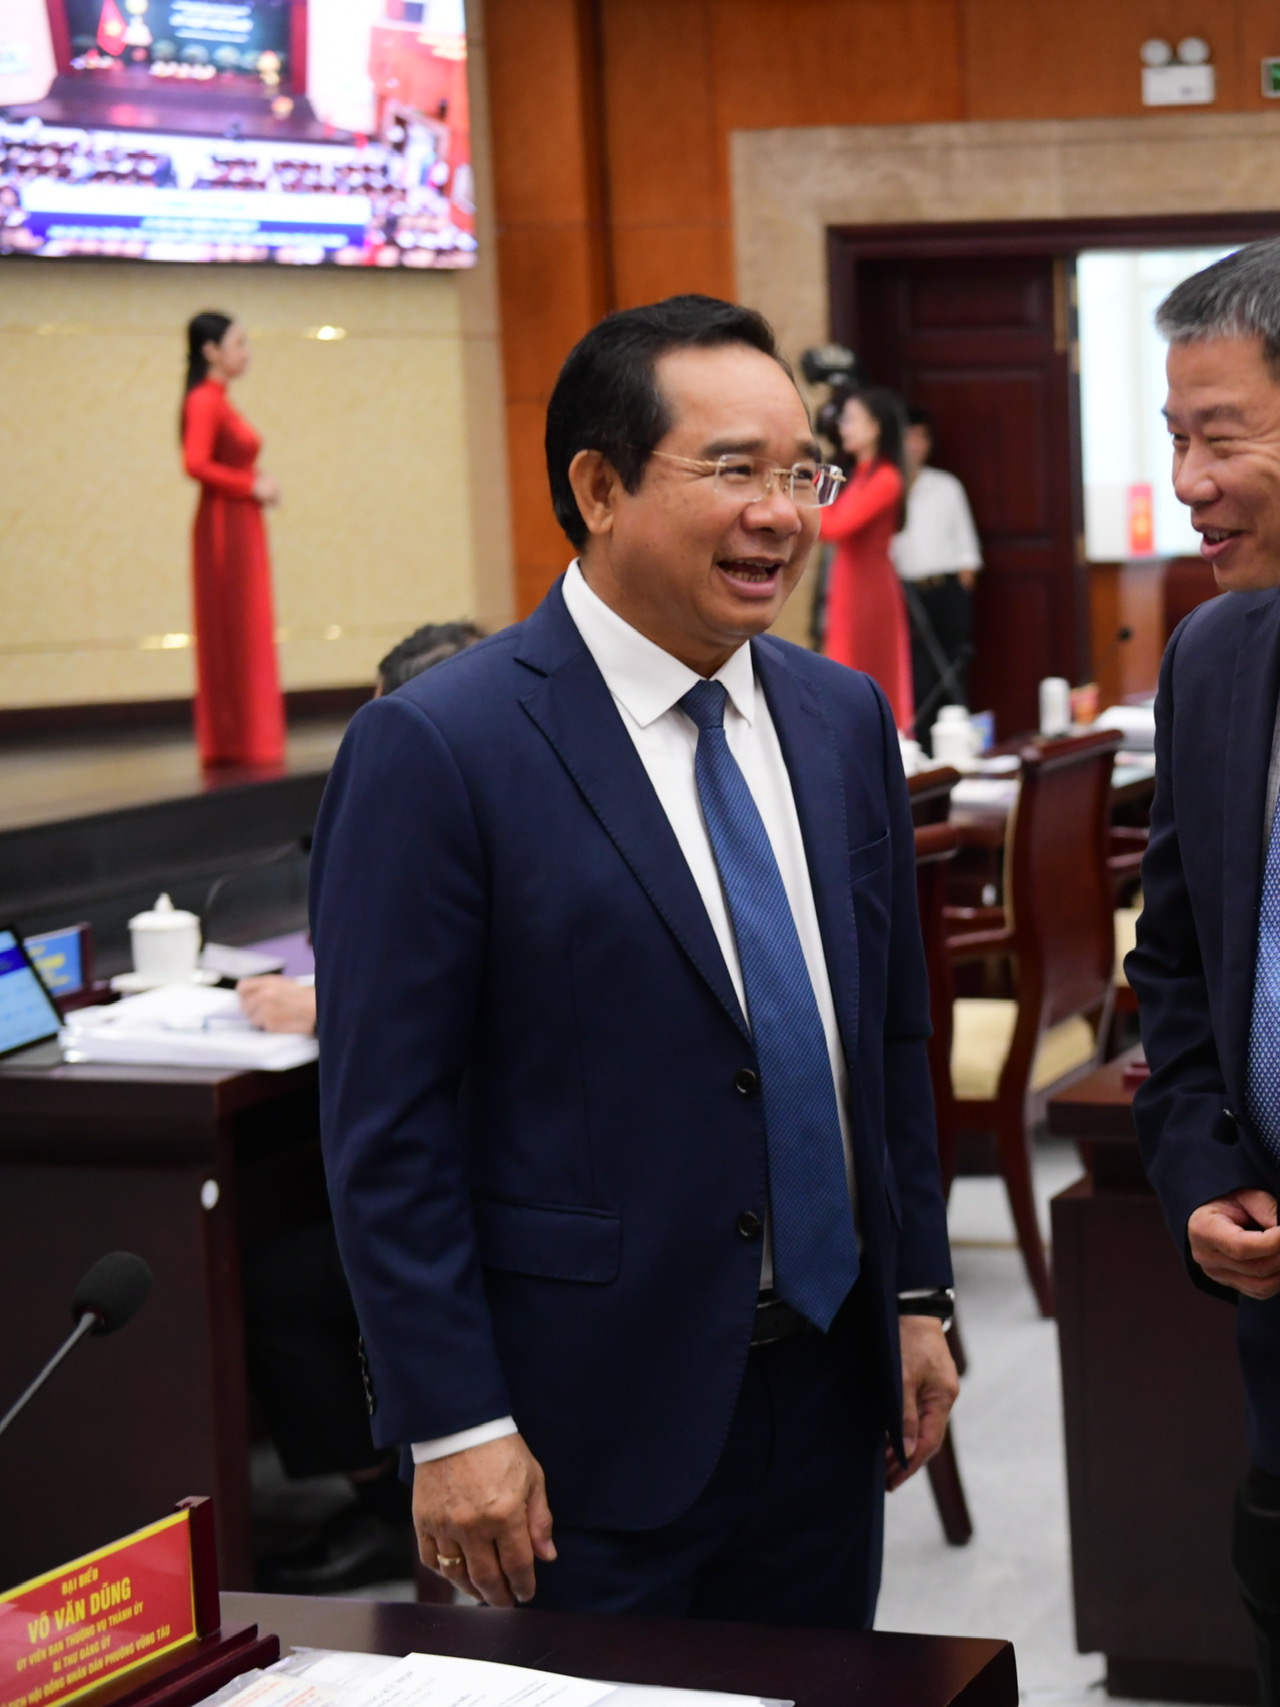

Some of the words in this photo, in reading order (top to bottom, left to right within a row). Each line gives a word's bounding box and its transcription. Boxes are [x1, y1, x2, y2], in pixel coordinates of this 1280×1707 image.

[28, 1610, 50, 1644] VÕ
[54, 1598, 86, 1632] VĂN
[90, 1576, 131, 1616] DŨNG
